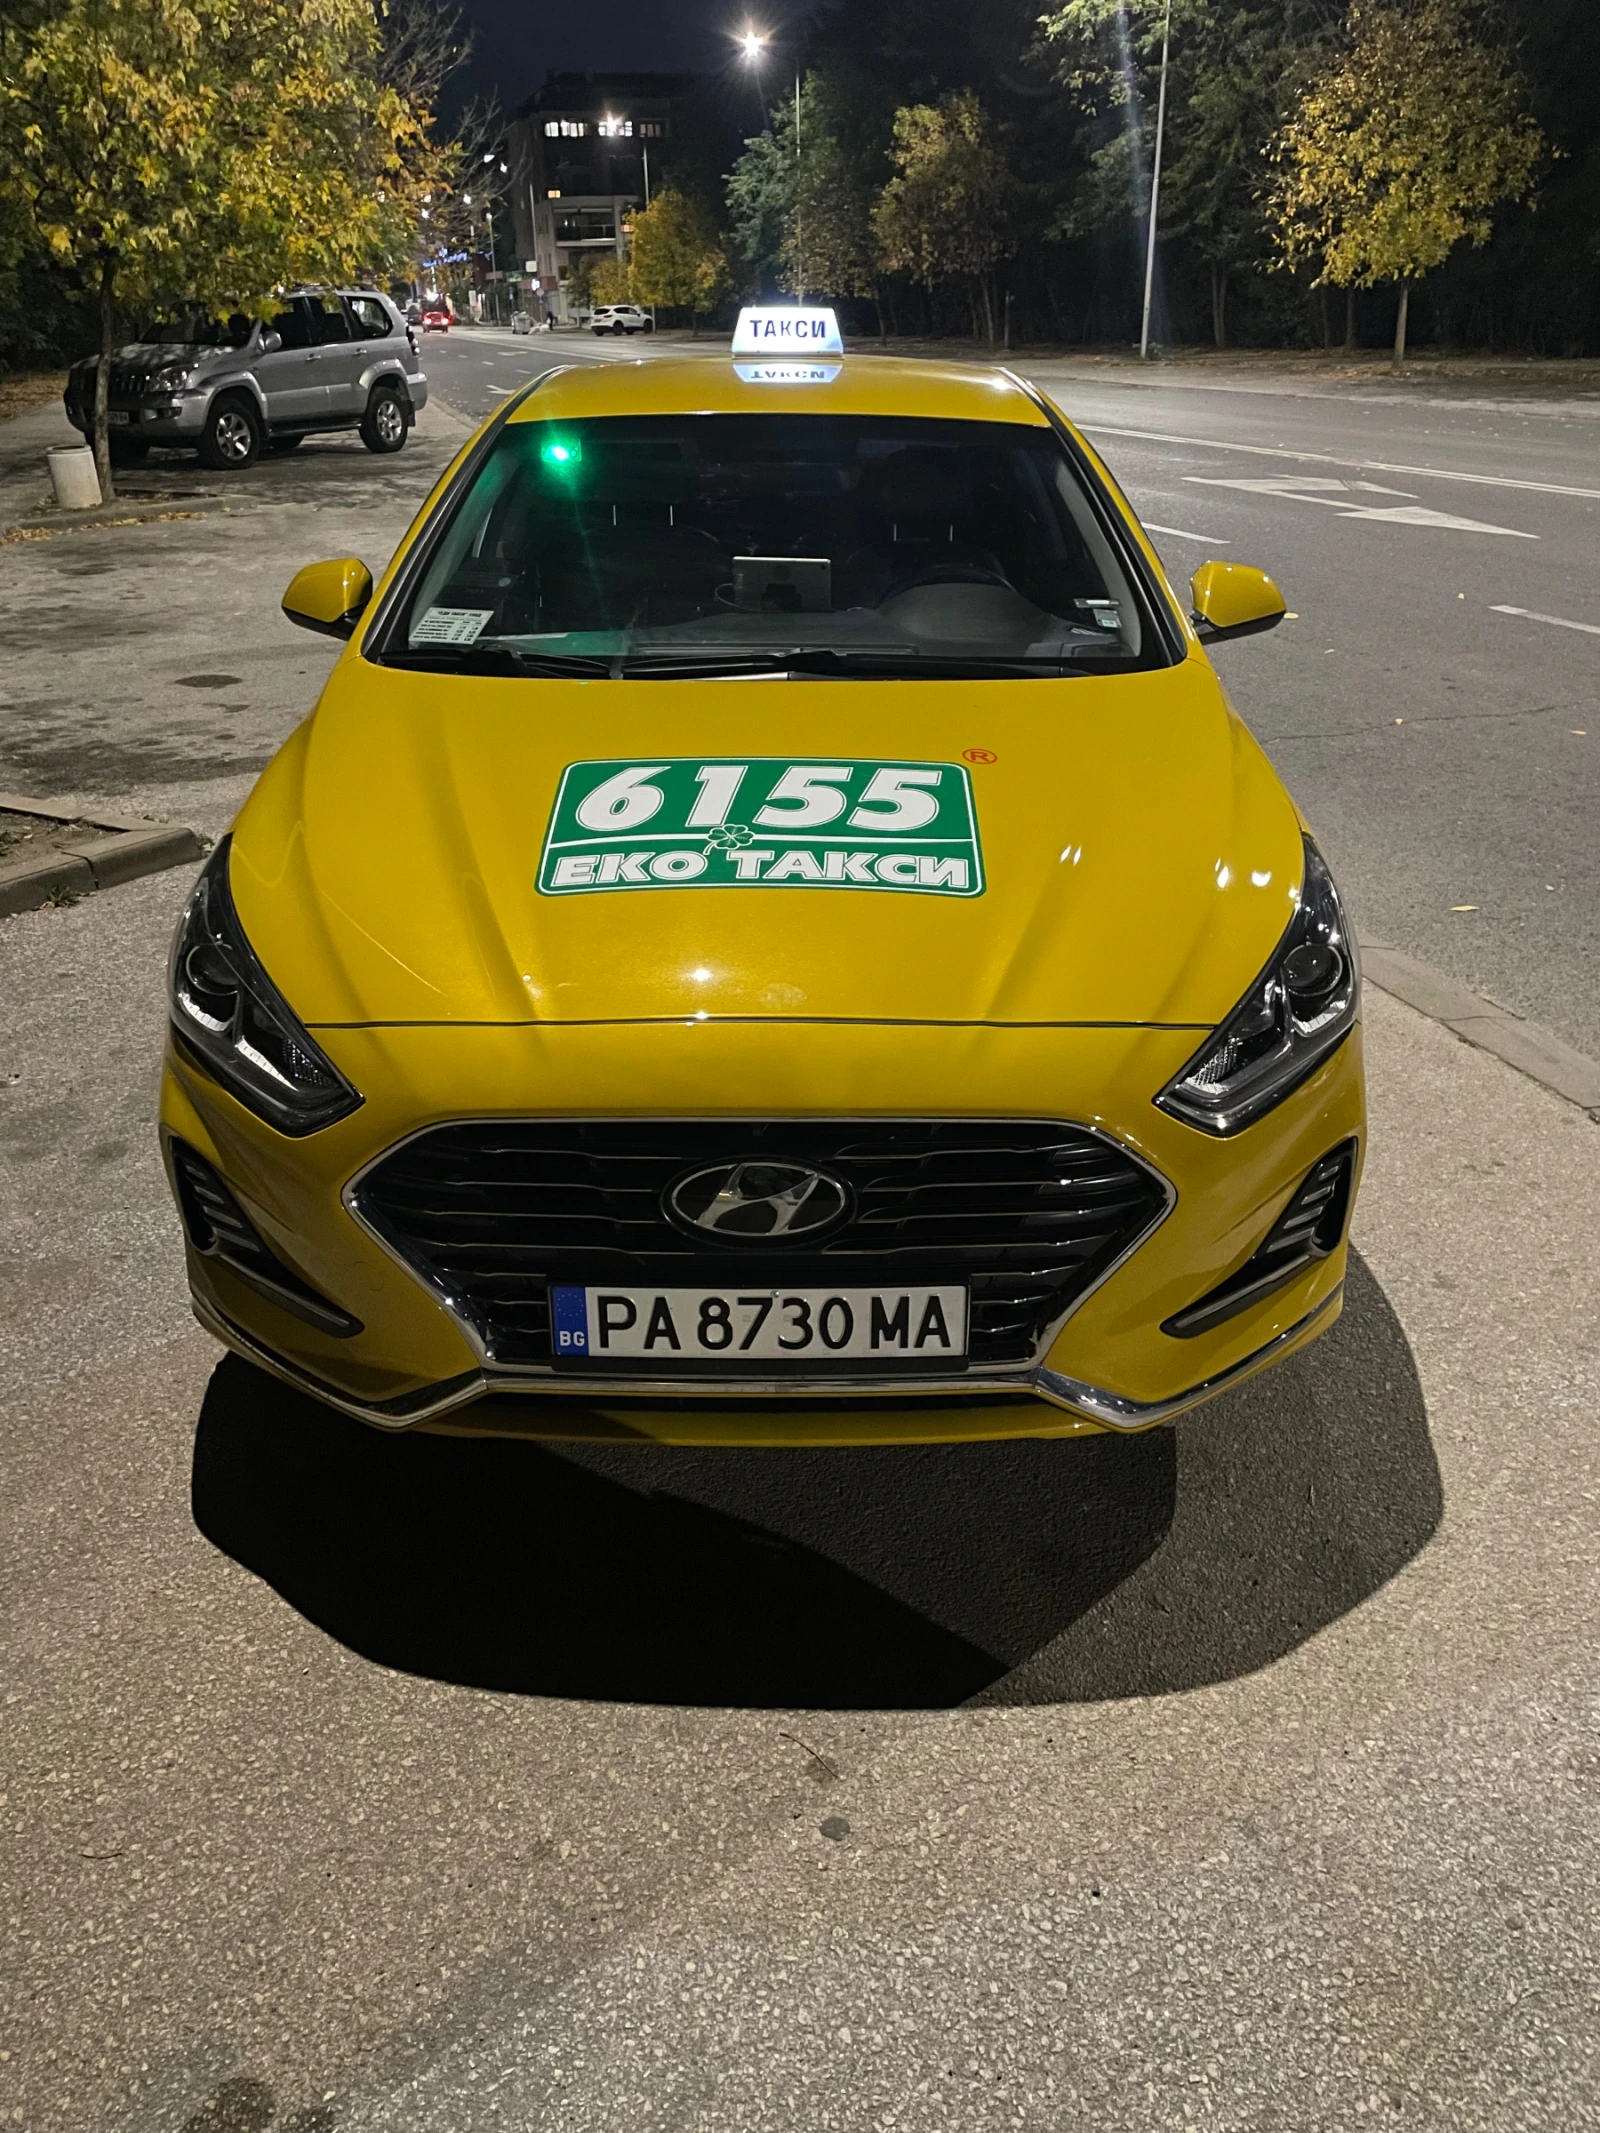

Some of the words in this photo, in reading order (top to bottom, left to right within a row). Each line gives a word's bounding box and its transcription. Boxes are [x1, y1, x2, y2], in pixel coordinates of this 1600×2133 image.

[750, 319, 826, 338] ТАКСИ
[575, 765, 942, 831] 6155
[549, 850, 706, 888] ЕКО
[725, 850, 969, 889] ТАКСИ
[559, 1330, 586, 1347] BG
[596, 1295, 682, 1350] PA
[697, 1296, 854, 1351] 8730
[870, 1293, 952, 1349] MA
